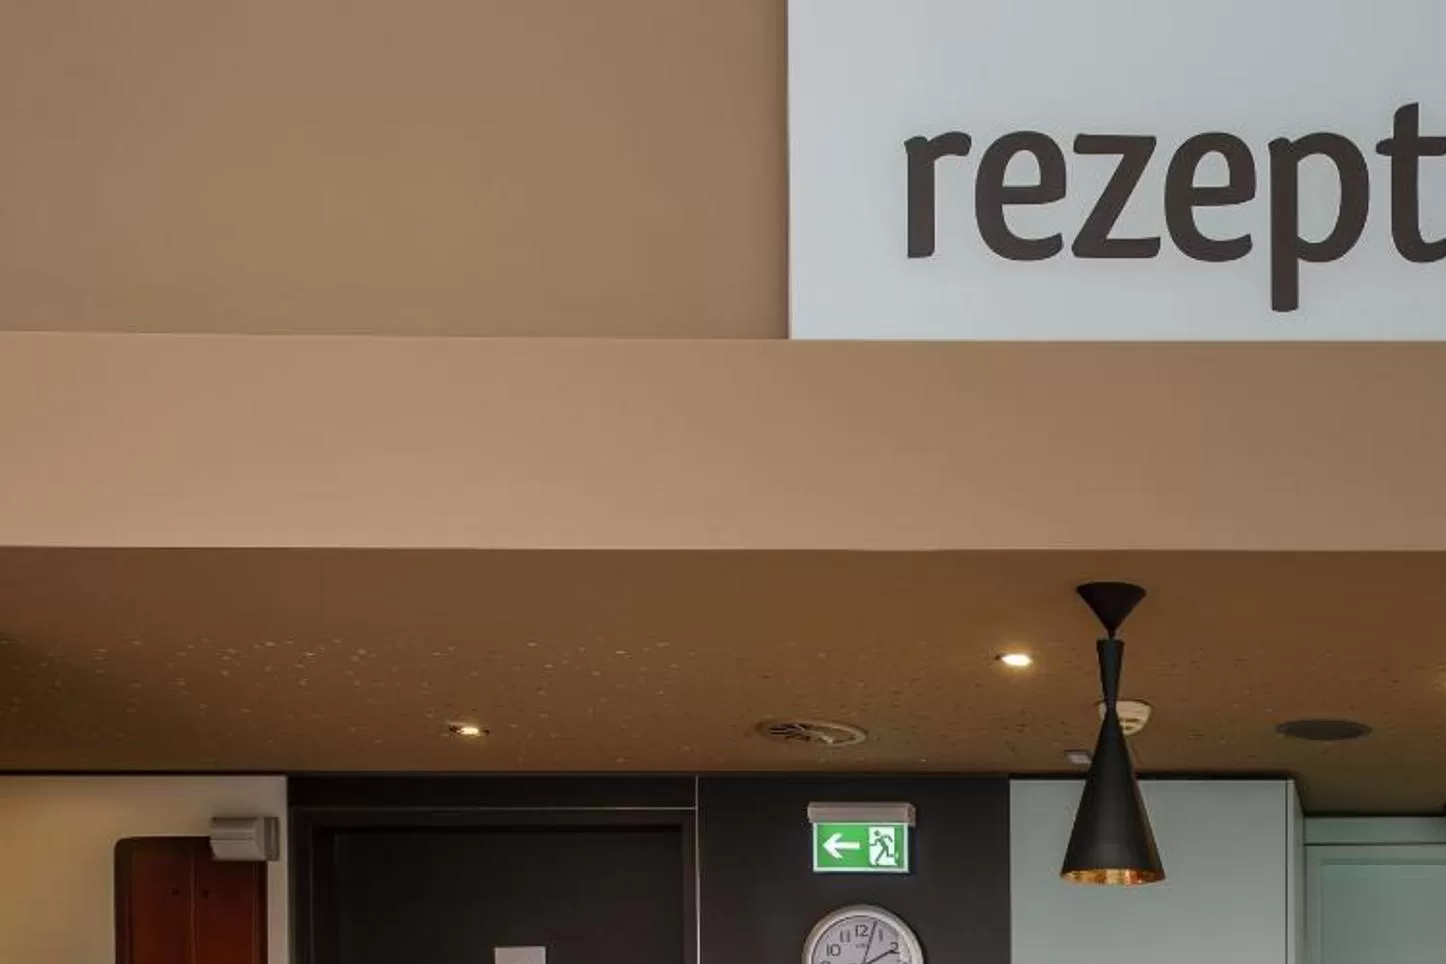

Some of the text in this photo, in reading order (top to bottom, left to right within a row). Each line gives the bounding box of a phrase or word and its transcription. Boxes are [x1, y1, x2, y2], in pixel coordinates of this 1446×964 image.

[840, 929, 850, 943] 11
[855, 924, 869, 937] 12
[826, 944, 840, 957] 10
